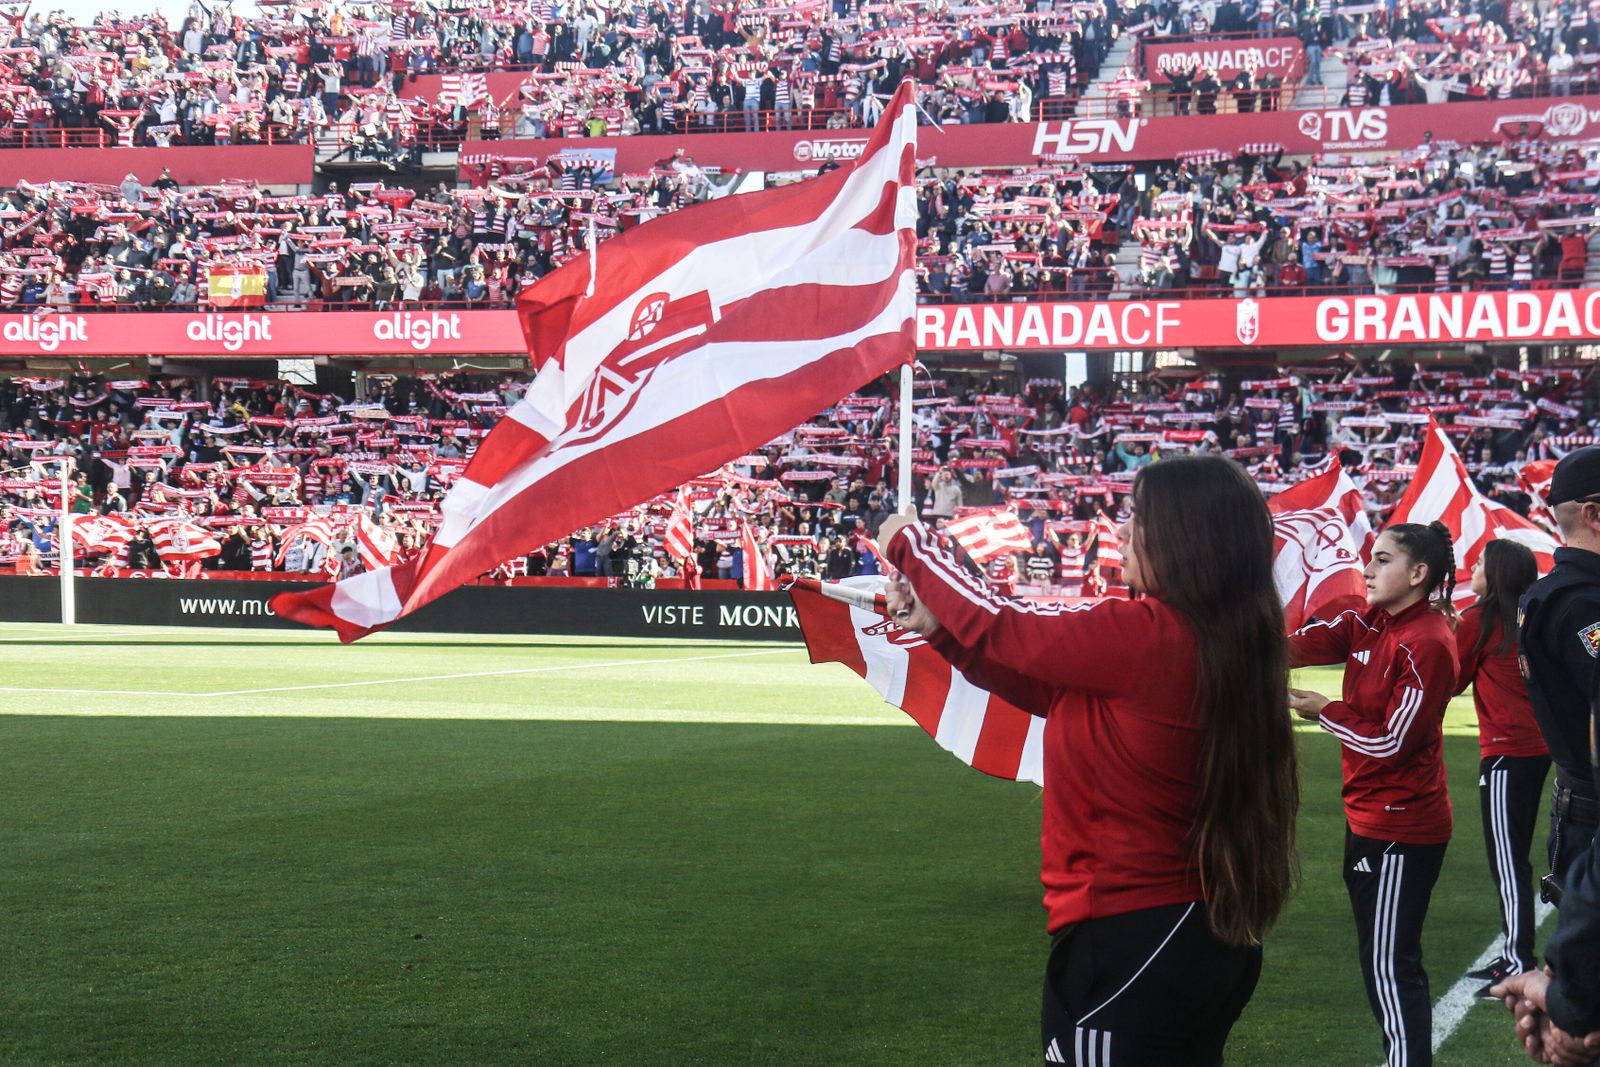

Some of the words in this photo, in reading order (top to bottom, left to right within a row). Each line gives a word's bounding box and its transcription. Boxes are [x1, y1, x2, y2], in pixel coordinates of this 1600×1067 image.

[1032, 118, 1141, 156] HSN
[1323, 108, 1387, 141] TVS
[3, 314, 88, 351] alight
[186, 314, 272, 351] alight
[373, 312, 461, 350] alight
[916, 302, 1181, 348] RANADACF
[642, 605, 704, 625] VISTE
